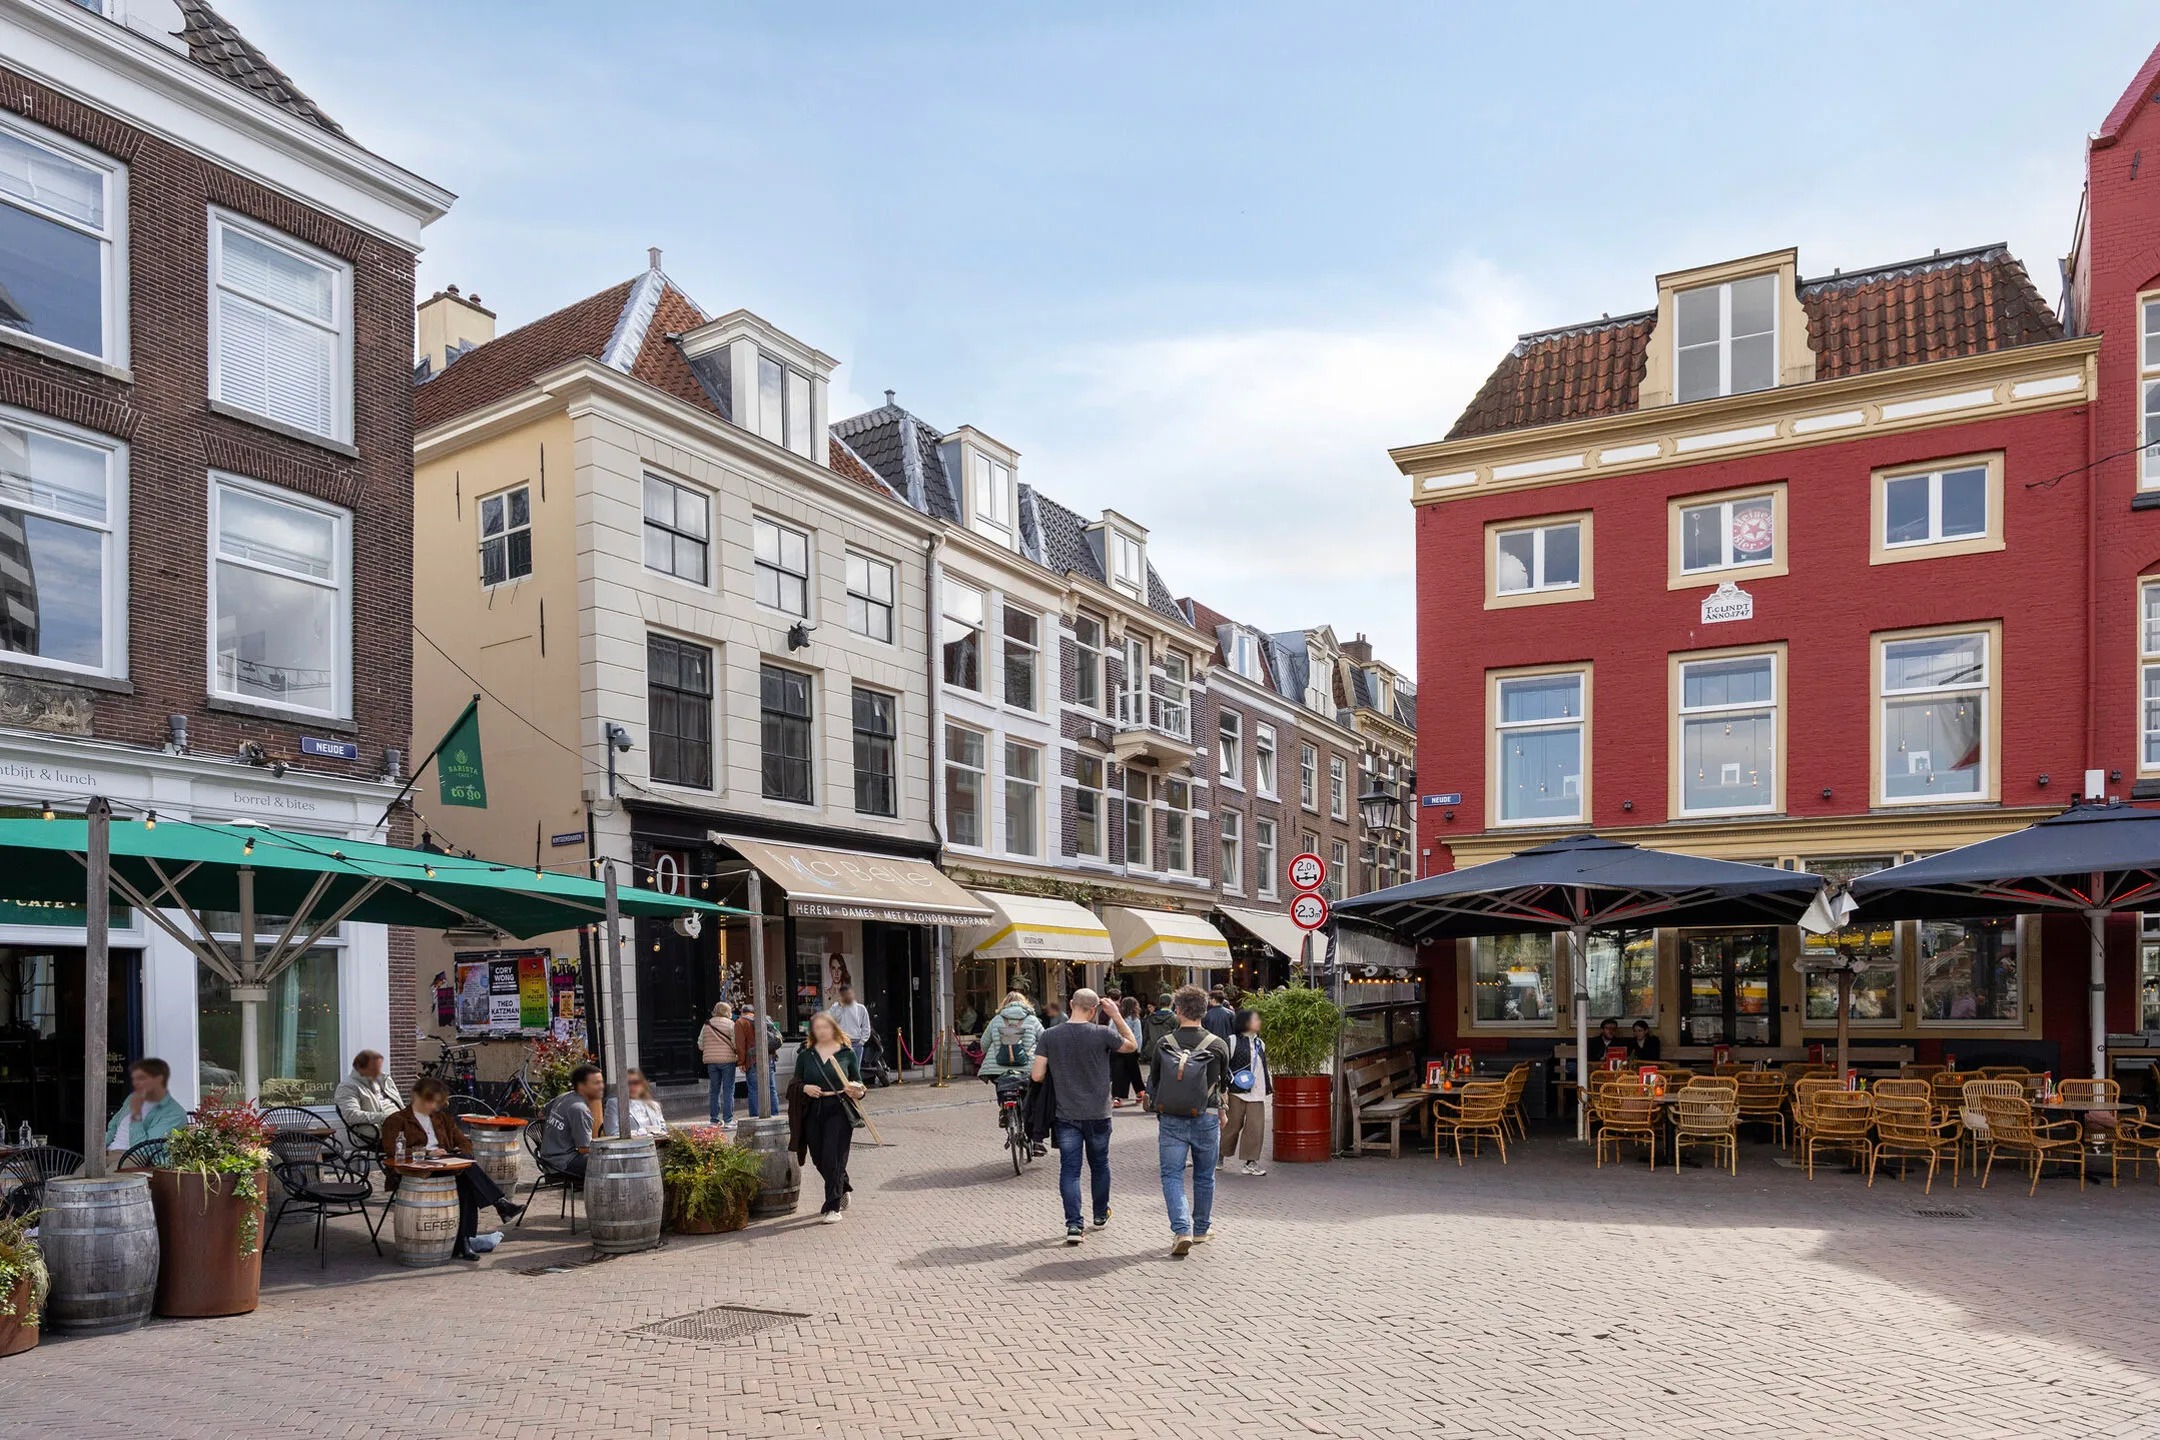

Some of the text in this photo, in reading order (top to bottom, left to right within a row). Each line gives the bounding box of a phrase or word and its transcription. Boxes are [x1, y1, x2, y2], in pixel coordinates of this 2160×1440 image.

[316, 742, 345, 755] NEUDE
[40, 768, 51, 781] &
[56, 769, 97, 786] lunch
[448, 765, 478, 776] BARISTA
[233, 791, 316, 811] borrel & bites
[451, 788, 481, 801] to go
[1432, 796, 1451, 804] NEUDE
[839, 861, 934, 887] Belle
[796, 903, 991, 926] HEREN DAMES MET & ZONDER AFSPRAAK
[495, 966, 513, 975] CORY
[494, 973, 515, 982] WONG
[497, 1000, 514, 1008] THEO
[491, 1007, 520, 1016] KATZMAN
[290, 1080, 301, 1093] &
[304, 1081, 335, 1093] taart
